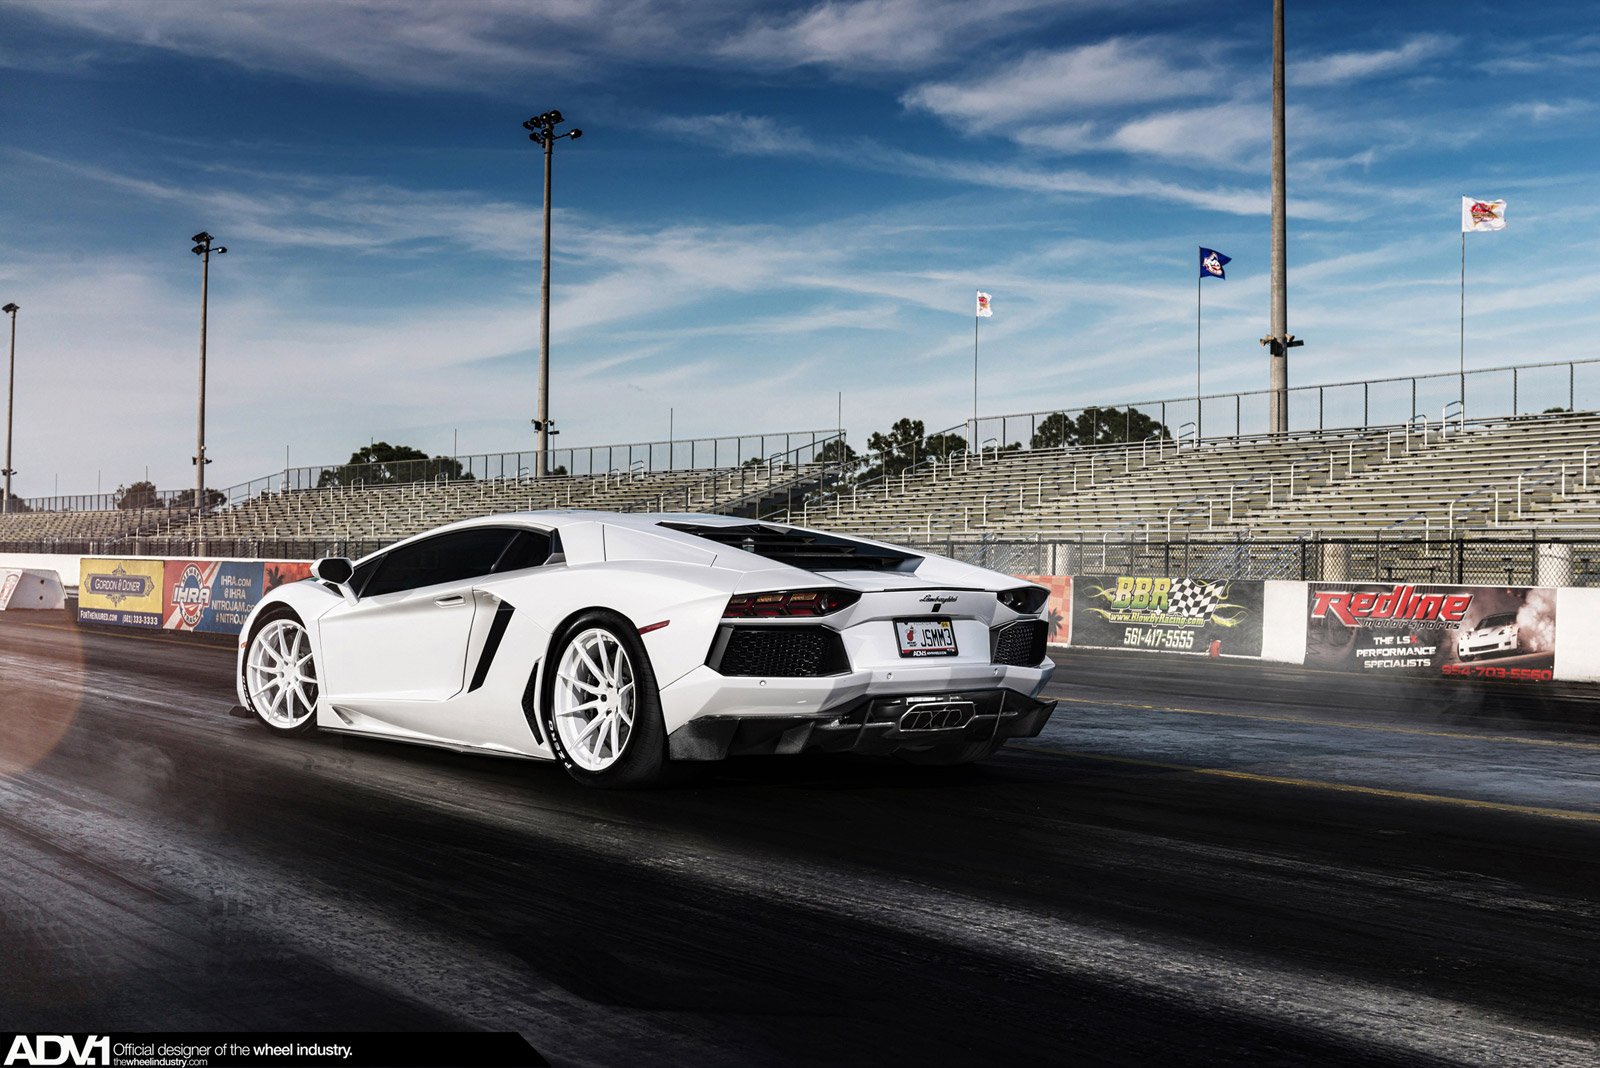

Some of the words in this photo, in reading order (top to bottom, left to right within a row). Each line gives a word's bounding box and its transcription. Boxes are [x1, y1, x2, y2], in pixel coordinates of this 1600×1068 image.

[94, 578, 118, 590] GORDON
[122, 579, 141, 591] DONER
[220, 575, 252, 587] IHRA.COM
[172, 586, 210, 604] IHRA
[1111, 576, 1171, 609] BBR
[211, 600, 255, 613] NITROJAM.CO
[1311, 585, 1474, 627] Redline
[133, 614, 158, 626] 333-3333
[184, 612, 199, 624] TRACK
[1109, 611, 1204, 627] www.BlowByRacing.com
[1363, 618, 1461, 631] motorsports
[920, 629, 952, 647] JSMM3
[1123, 627, 1195, 649] 561-417-5555
[1373, 636, 1394, 645] THE
[1356, 646, 1437, 658] PERFORMANCE
[1364, 658, 1431, 669] SPECIALISTS
[1441, 664, 1553, 681] 954-703-5560
